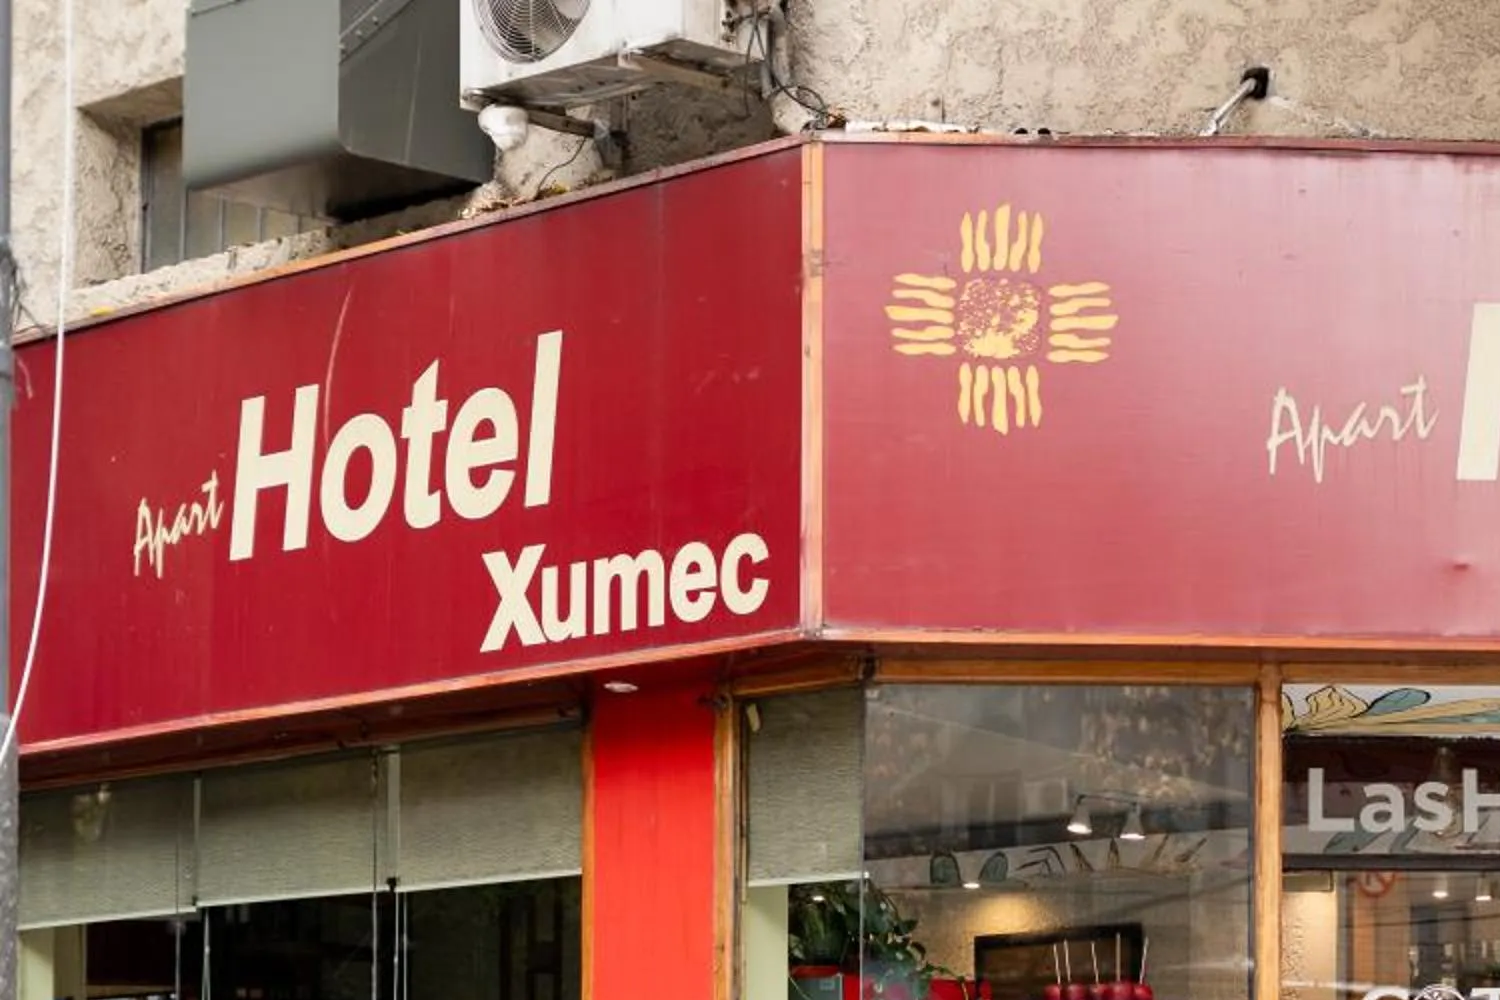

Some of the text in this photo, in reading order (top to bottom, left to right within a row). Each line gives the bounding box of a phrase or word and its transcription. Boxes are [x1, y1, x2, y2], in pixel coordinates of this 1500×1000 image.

[133, 330, 563, 578] Apart Hotel
[1266, 374, 1441, 483] Apart
[479, 533, 770, 653] Xumec
